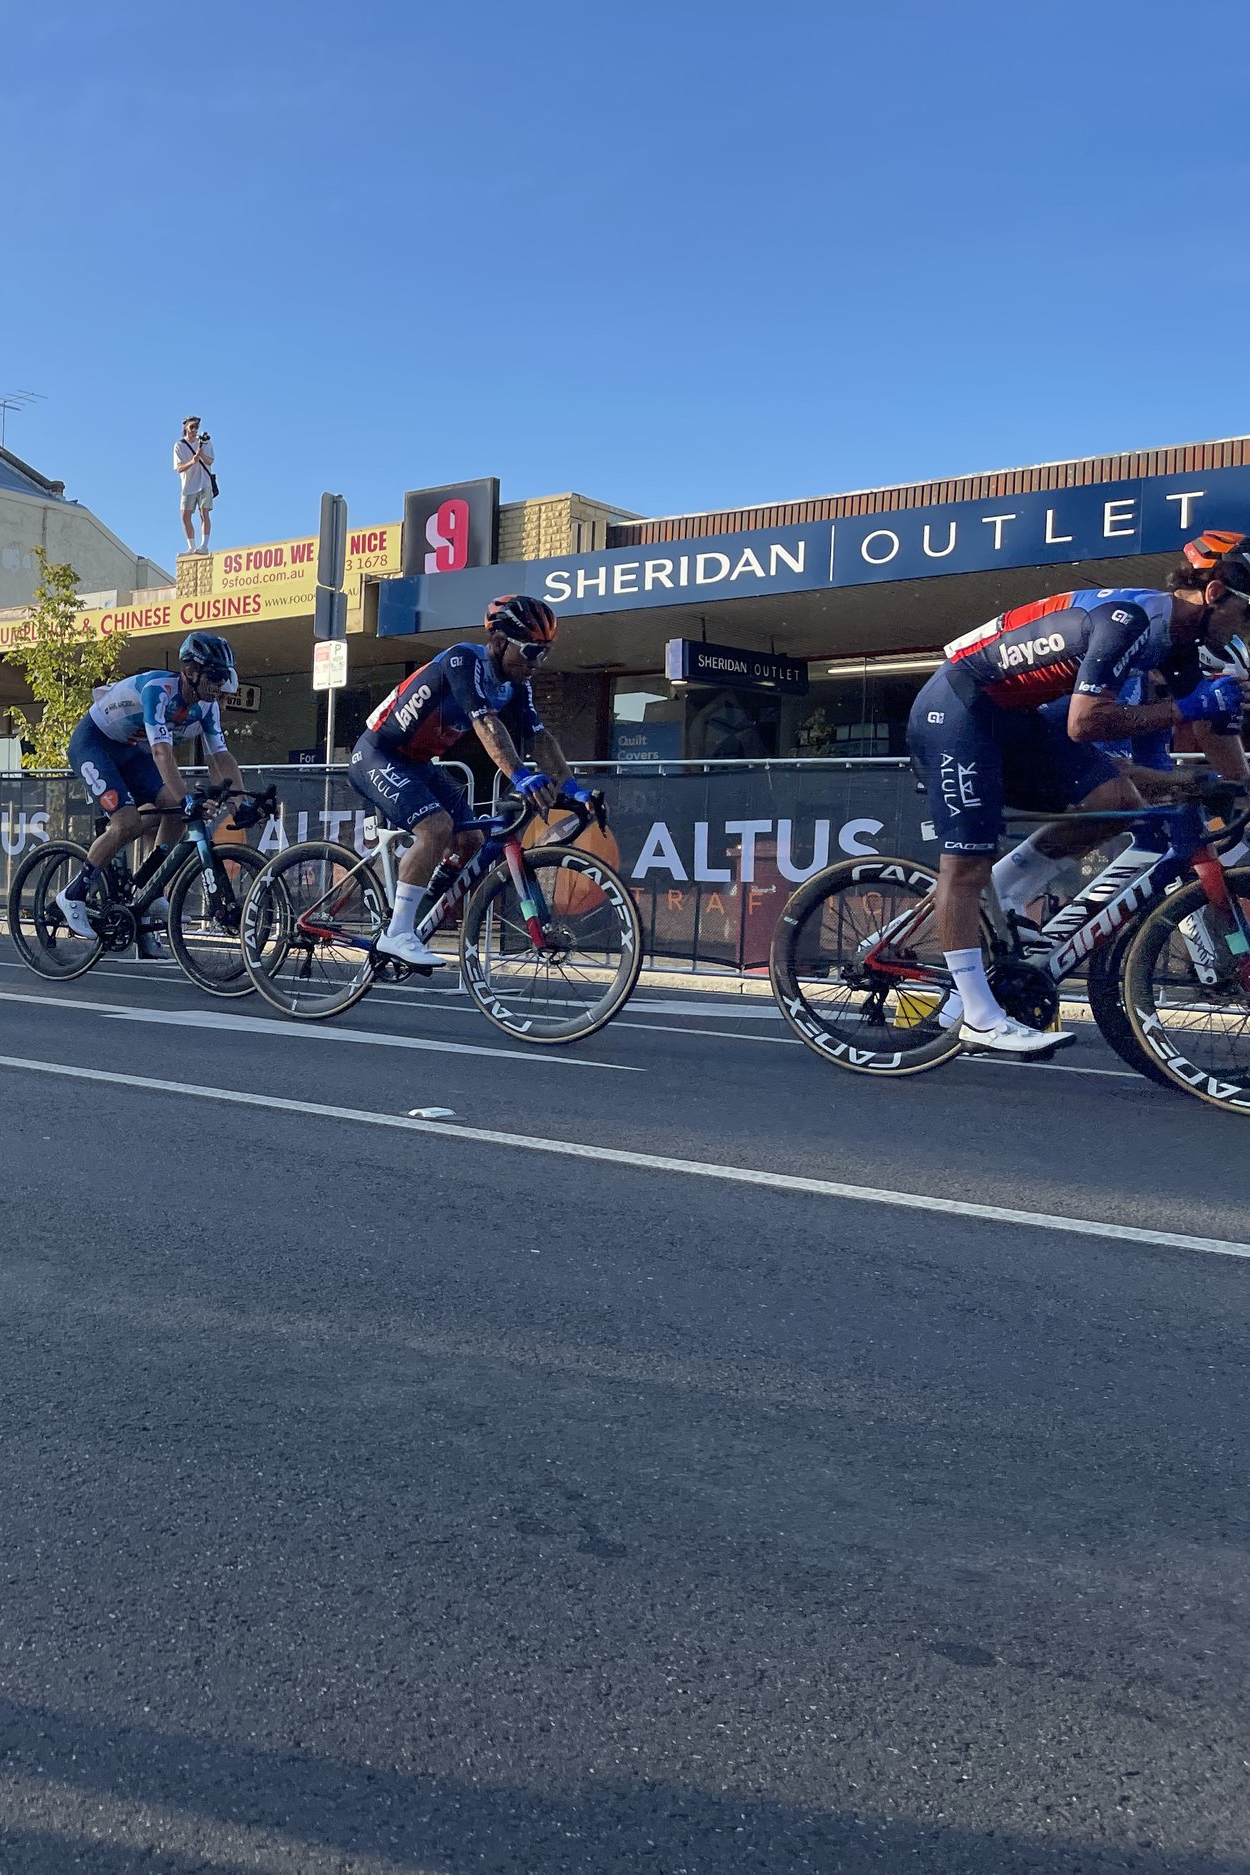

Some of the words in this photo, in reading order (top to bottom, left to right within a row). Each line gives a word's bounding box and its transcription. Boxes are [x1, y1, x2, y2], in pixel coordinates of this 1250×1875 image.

[224, 552, 243, 574] 9S
[245, 547, 287, 572] FOOD,
[290, 542, 315, 564] WE
[350, 530, 388, 555] NICE
[358, 554, 388, 570] 1678
[542, 540, 806, 603] SHERIDAN
[860, 489, 1205, 566] OUTLET
[222, 568, 305, 589] 9sfood.com.au
[100, 606, 171, 635] CHINESE
[180, 593, 262, 625] CUISINES
[698, 654, 747, 674] SHERIDAN
[754, 664, 800, 682] OUTLET
[299, 752, 317, 764] For
[617, 735, 648, 746] Quilt
[617, 750, 660, 761] Covers
[366, 768, 401, 805] ALULA
[940, 752, 962, 818] ALULA
[406, 801, 442, 826] CADEX
[630, 817, 885, 883] ALTUS
[851, 862, 938, 896] CAD
[560, 854, 634, 953] CADEX
[1050, 872, 1153, 982] GIANT
[464, 936, 533, 1034] CADEX
[782, 994, 902, 1069] CADEX
